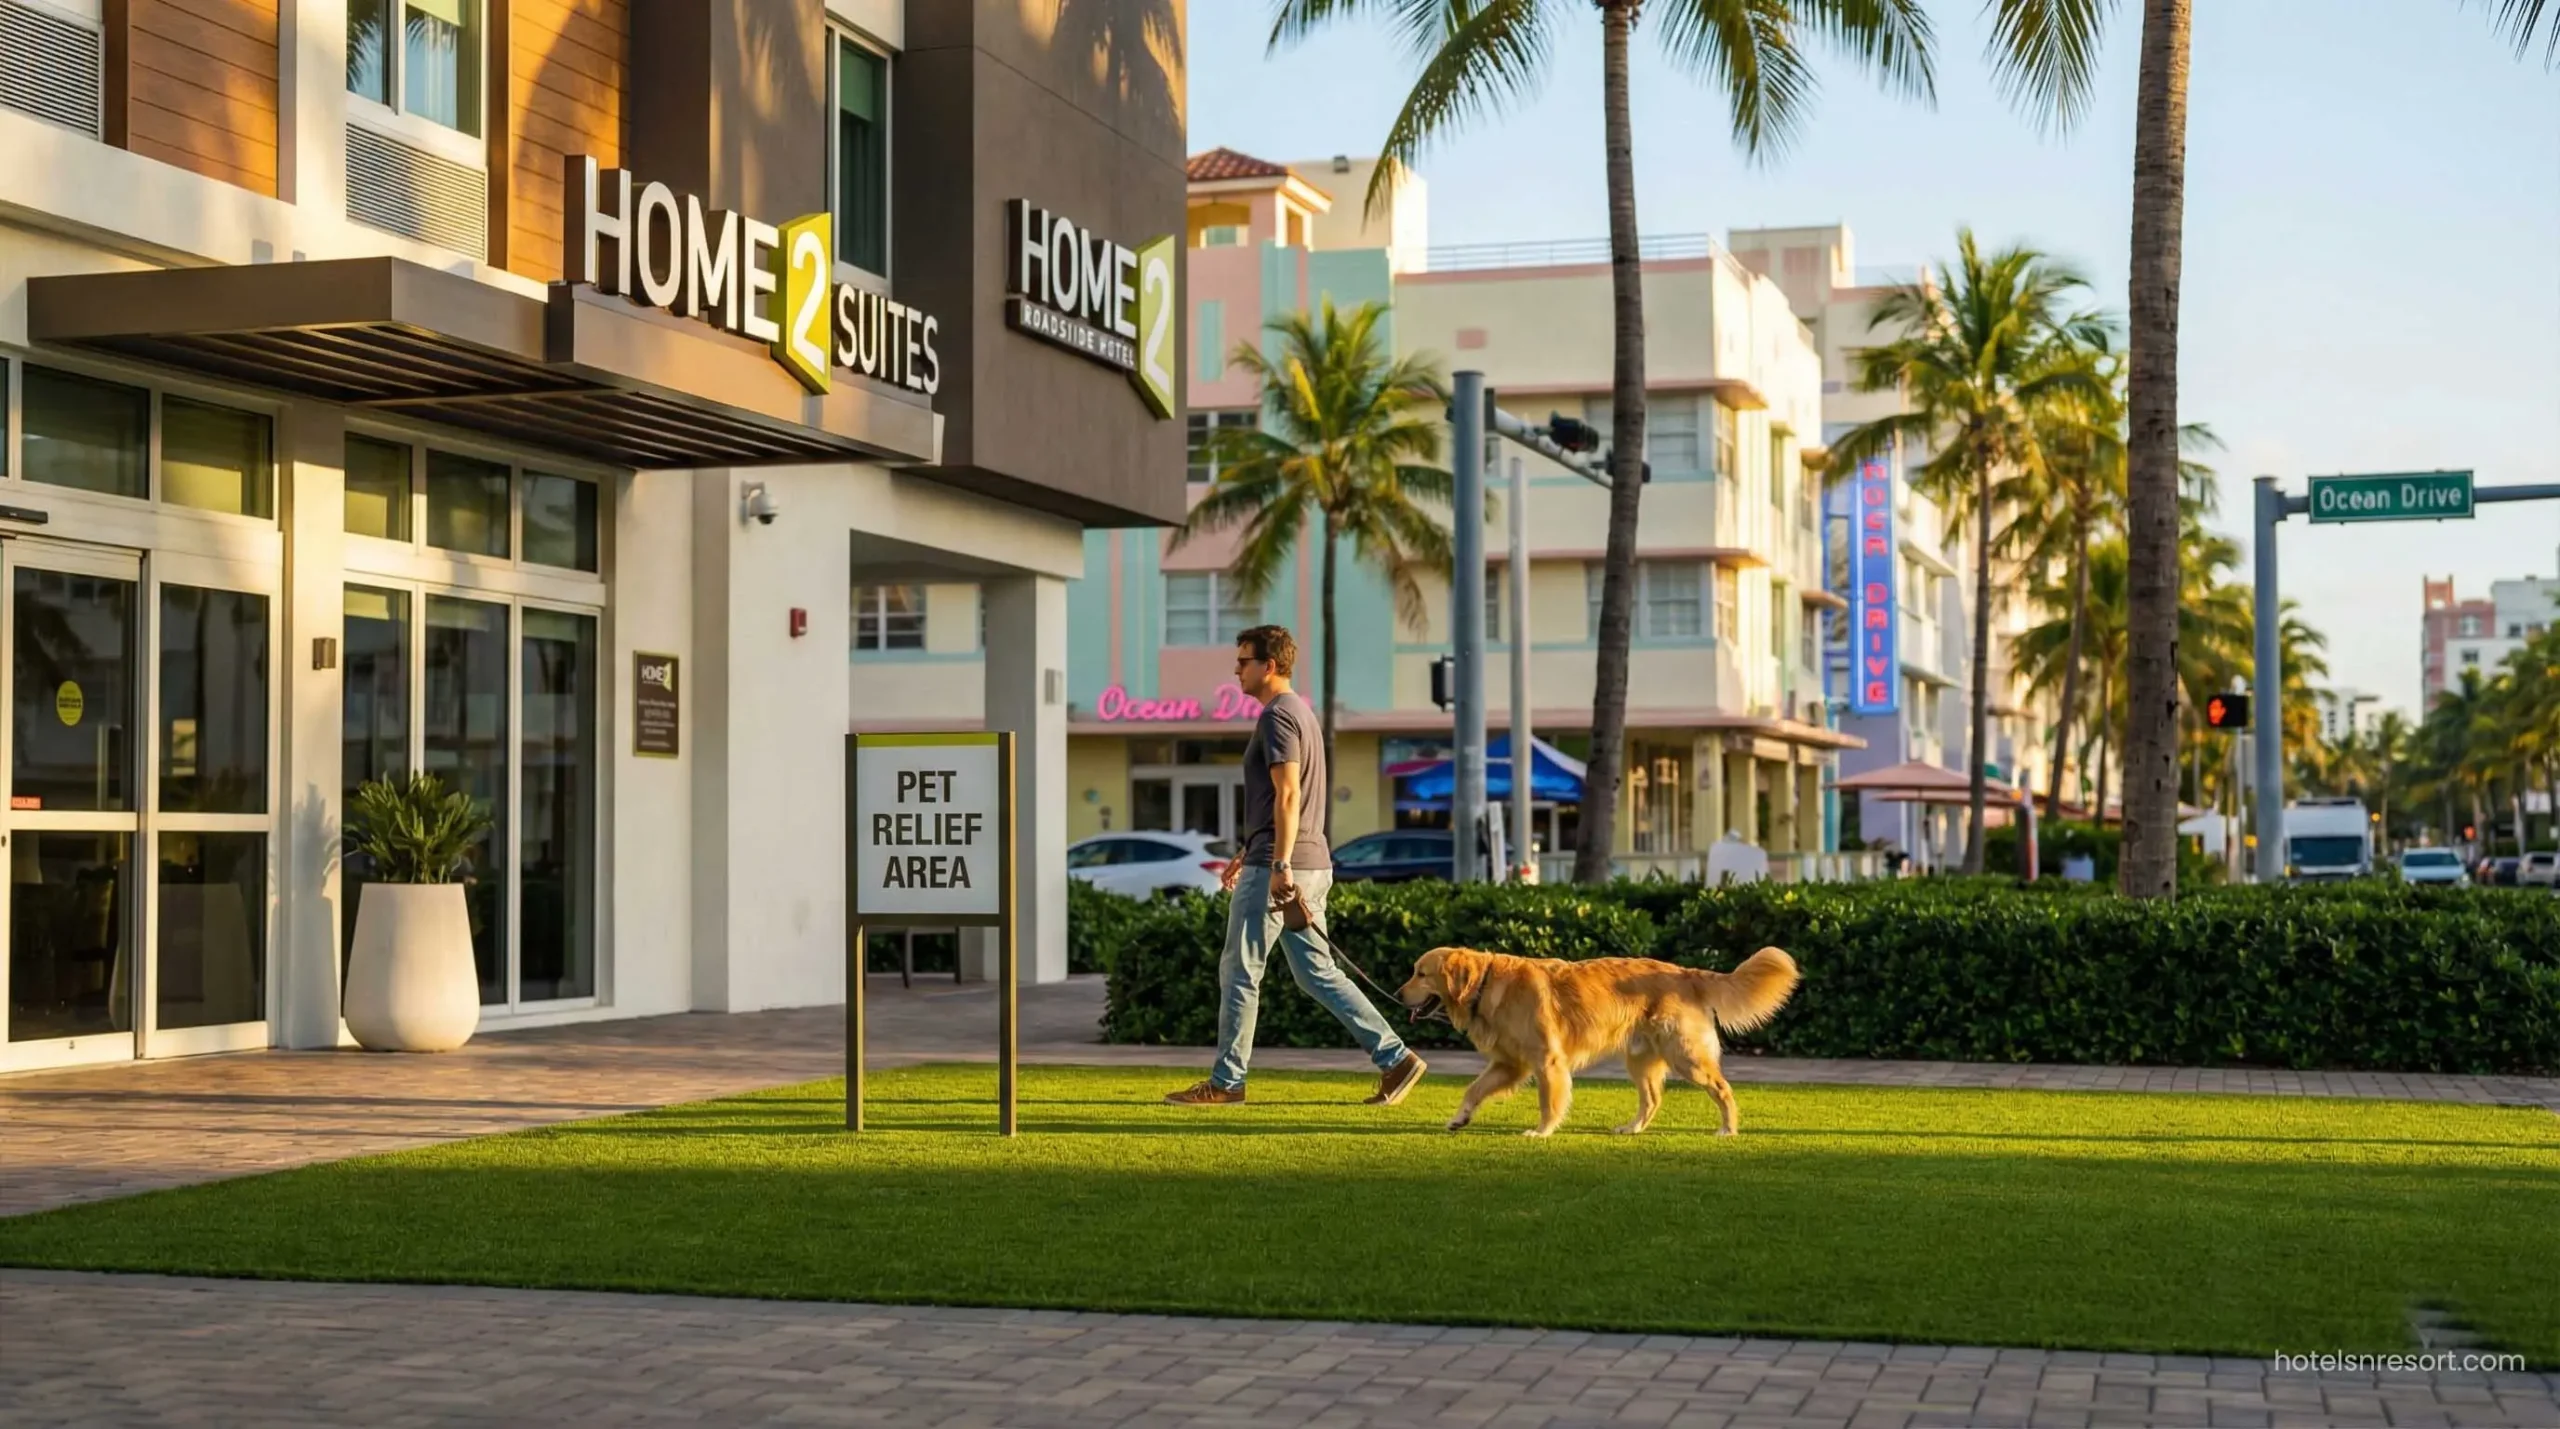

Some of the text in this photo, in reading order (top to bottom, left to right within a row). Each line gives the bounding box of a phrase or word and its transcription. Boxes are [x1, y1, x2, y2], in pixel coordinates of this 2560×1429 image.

[838, 283, 940, 395] SUITES
[1100, 338, 1135, 368] HOTEL
[2319, 482, 2462, 512] Ocean Drive
[1865, 582, 1888, 704] DRIVE
[1098, 684, 1202, 721] Ocean
[897, 770, 957, 803] PET
[873, 813, 982, 845] RELIEF
[882, 856, 971, 888] AREA
